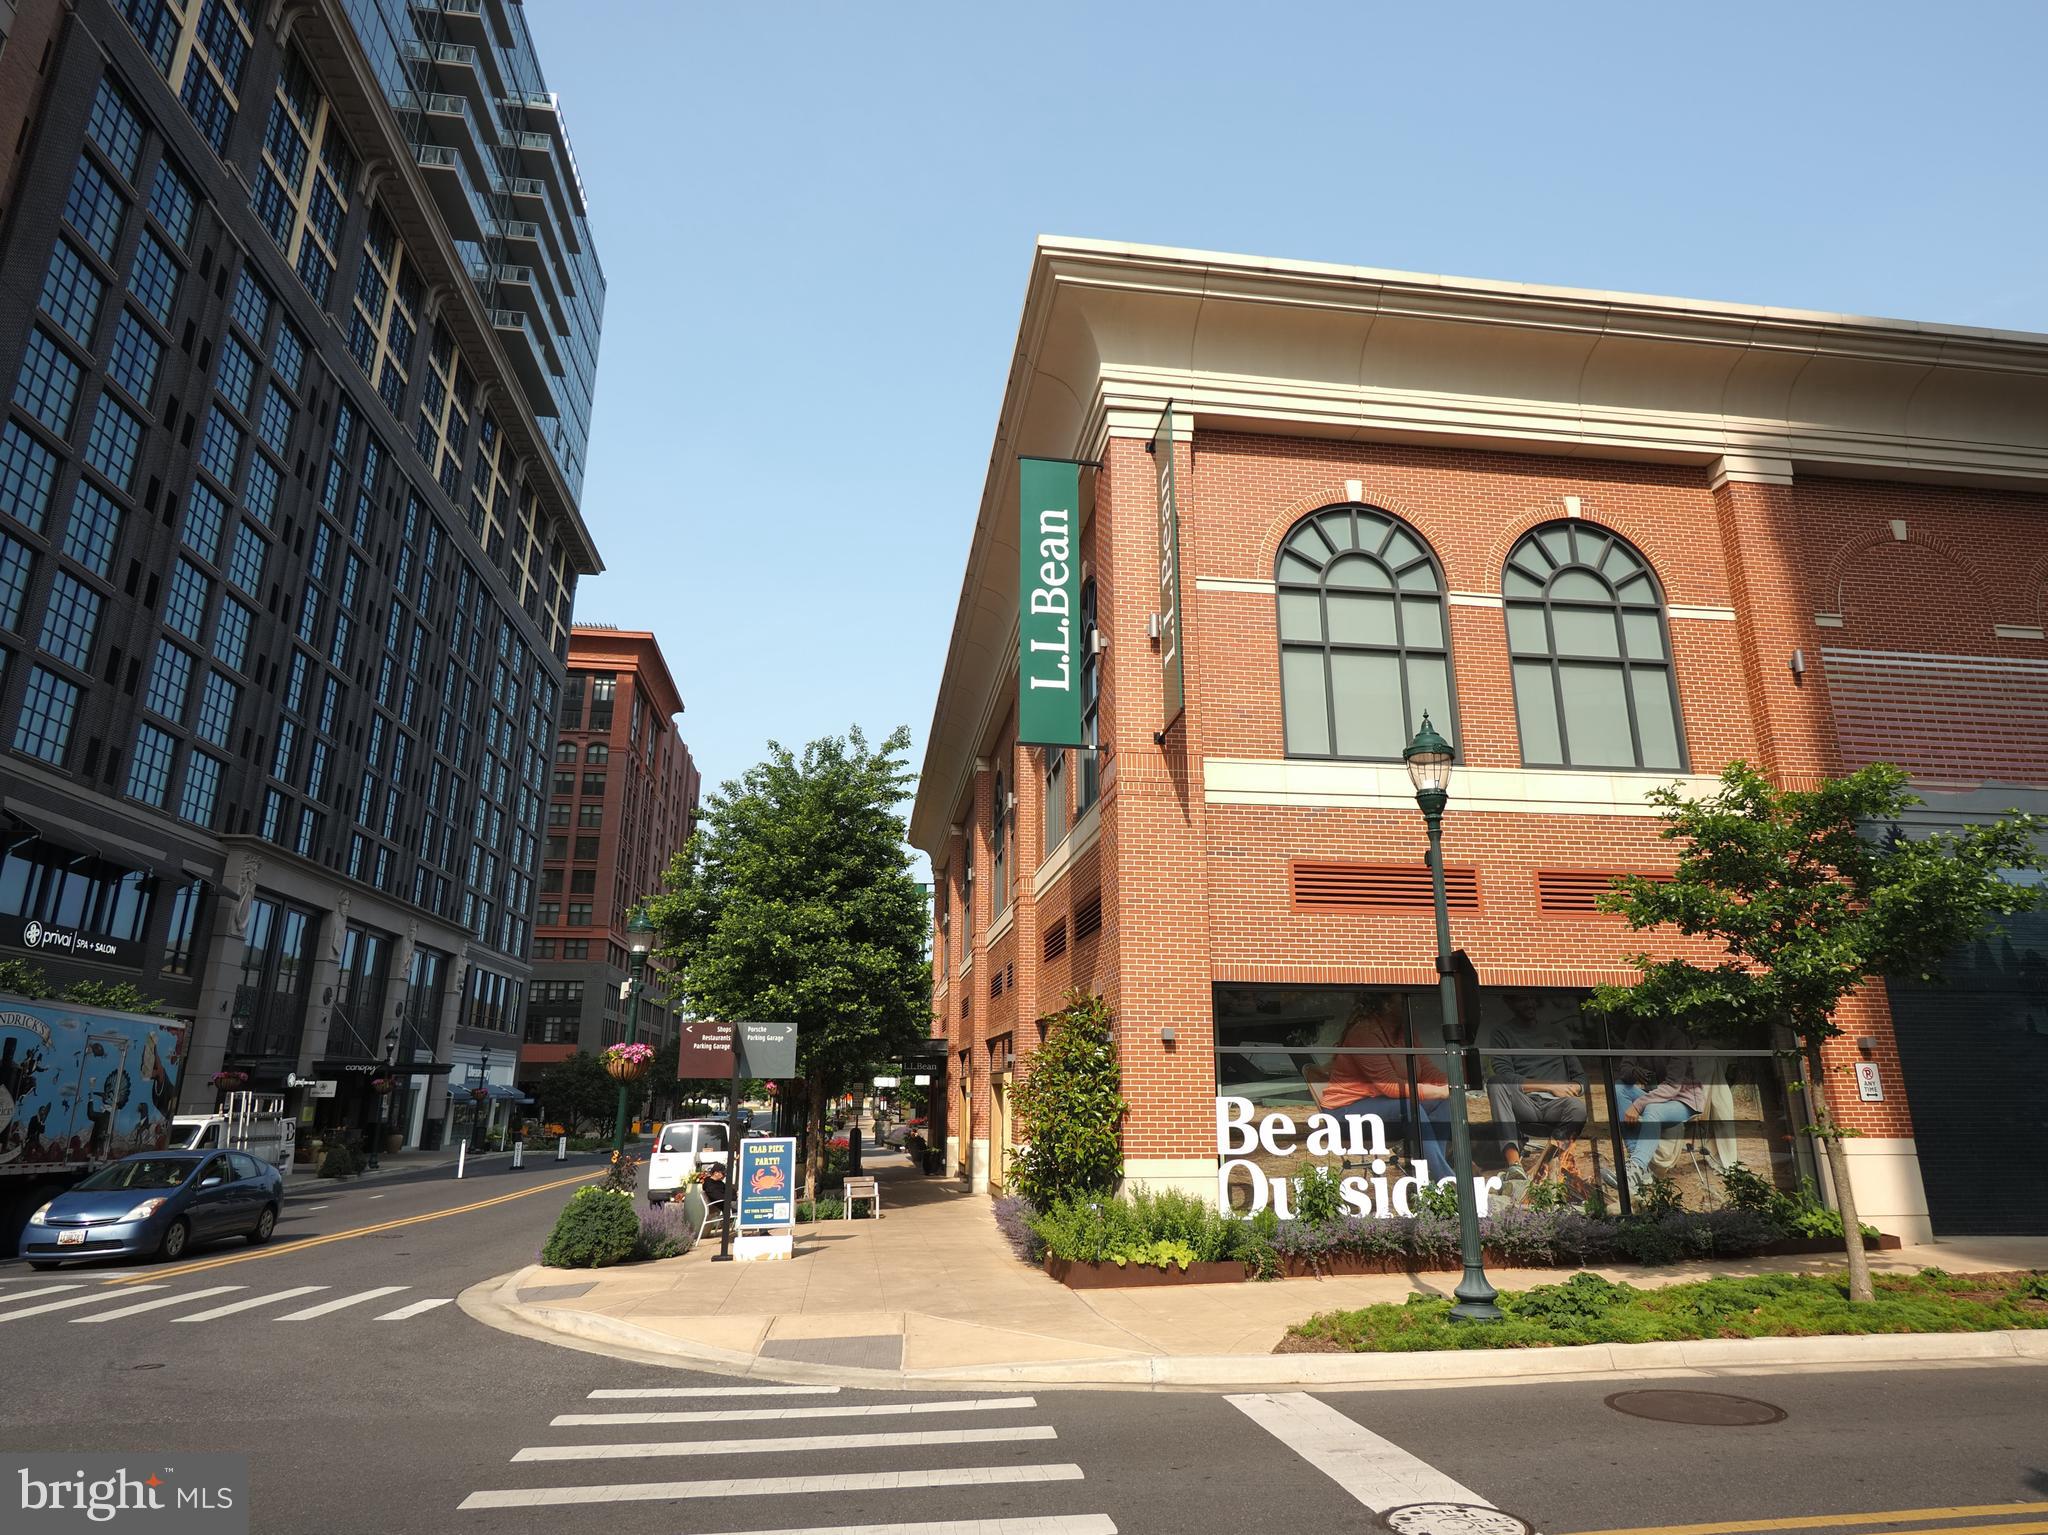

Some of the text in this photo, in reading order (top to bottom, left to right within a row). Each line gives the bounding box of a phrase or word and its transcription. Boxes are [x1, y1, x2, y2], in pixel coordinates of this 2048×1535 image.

[1161, 463, 1176, 668] L.L.Bean
[1030, 509, 1069, 692] L.L.Bean
[41, 929, 73, 948] privai
[76, 939, 89, 949] SPA
[94, 942, 117, 955] SALON
[717, 1026, 732, 1034] Shops
[747, 1034, 784, 1043] Parking Garage
[693, 1043, 731, 1051] Parking Garage
[345, 1064, 379, 1076] canopy
[903, 1062, 937, 1070] L.L.Bean
[749, 1145, 785, 1154] CRAB PICK
[755, 1157, 780, 1166] PARTY!
